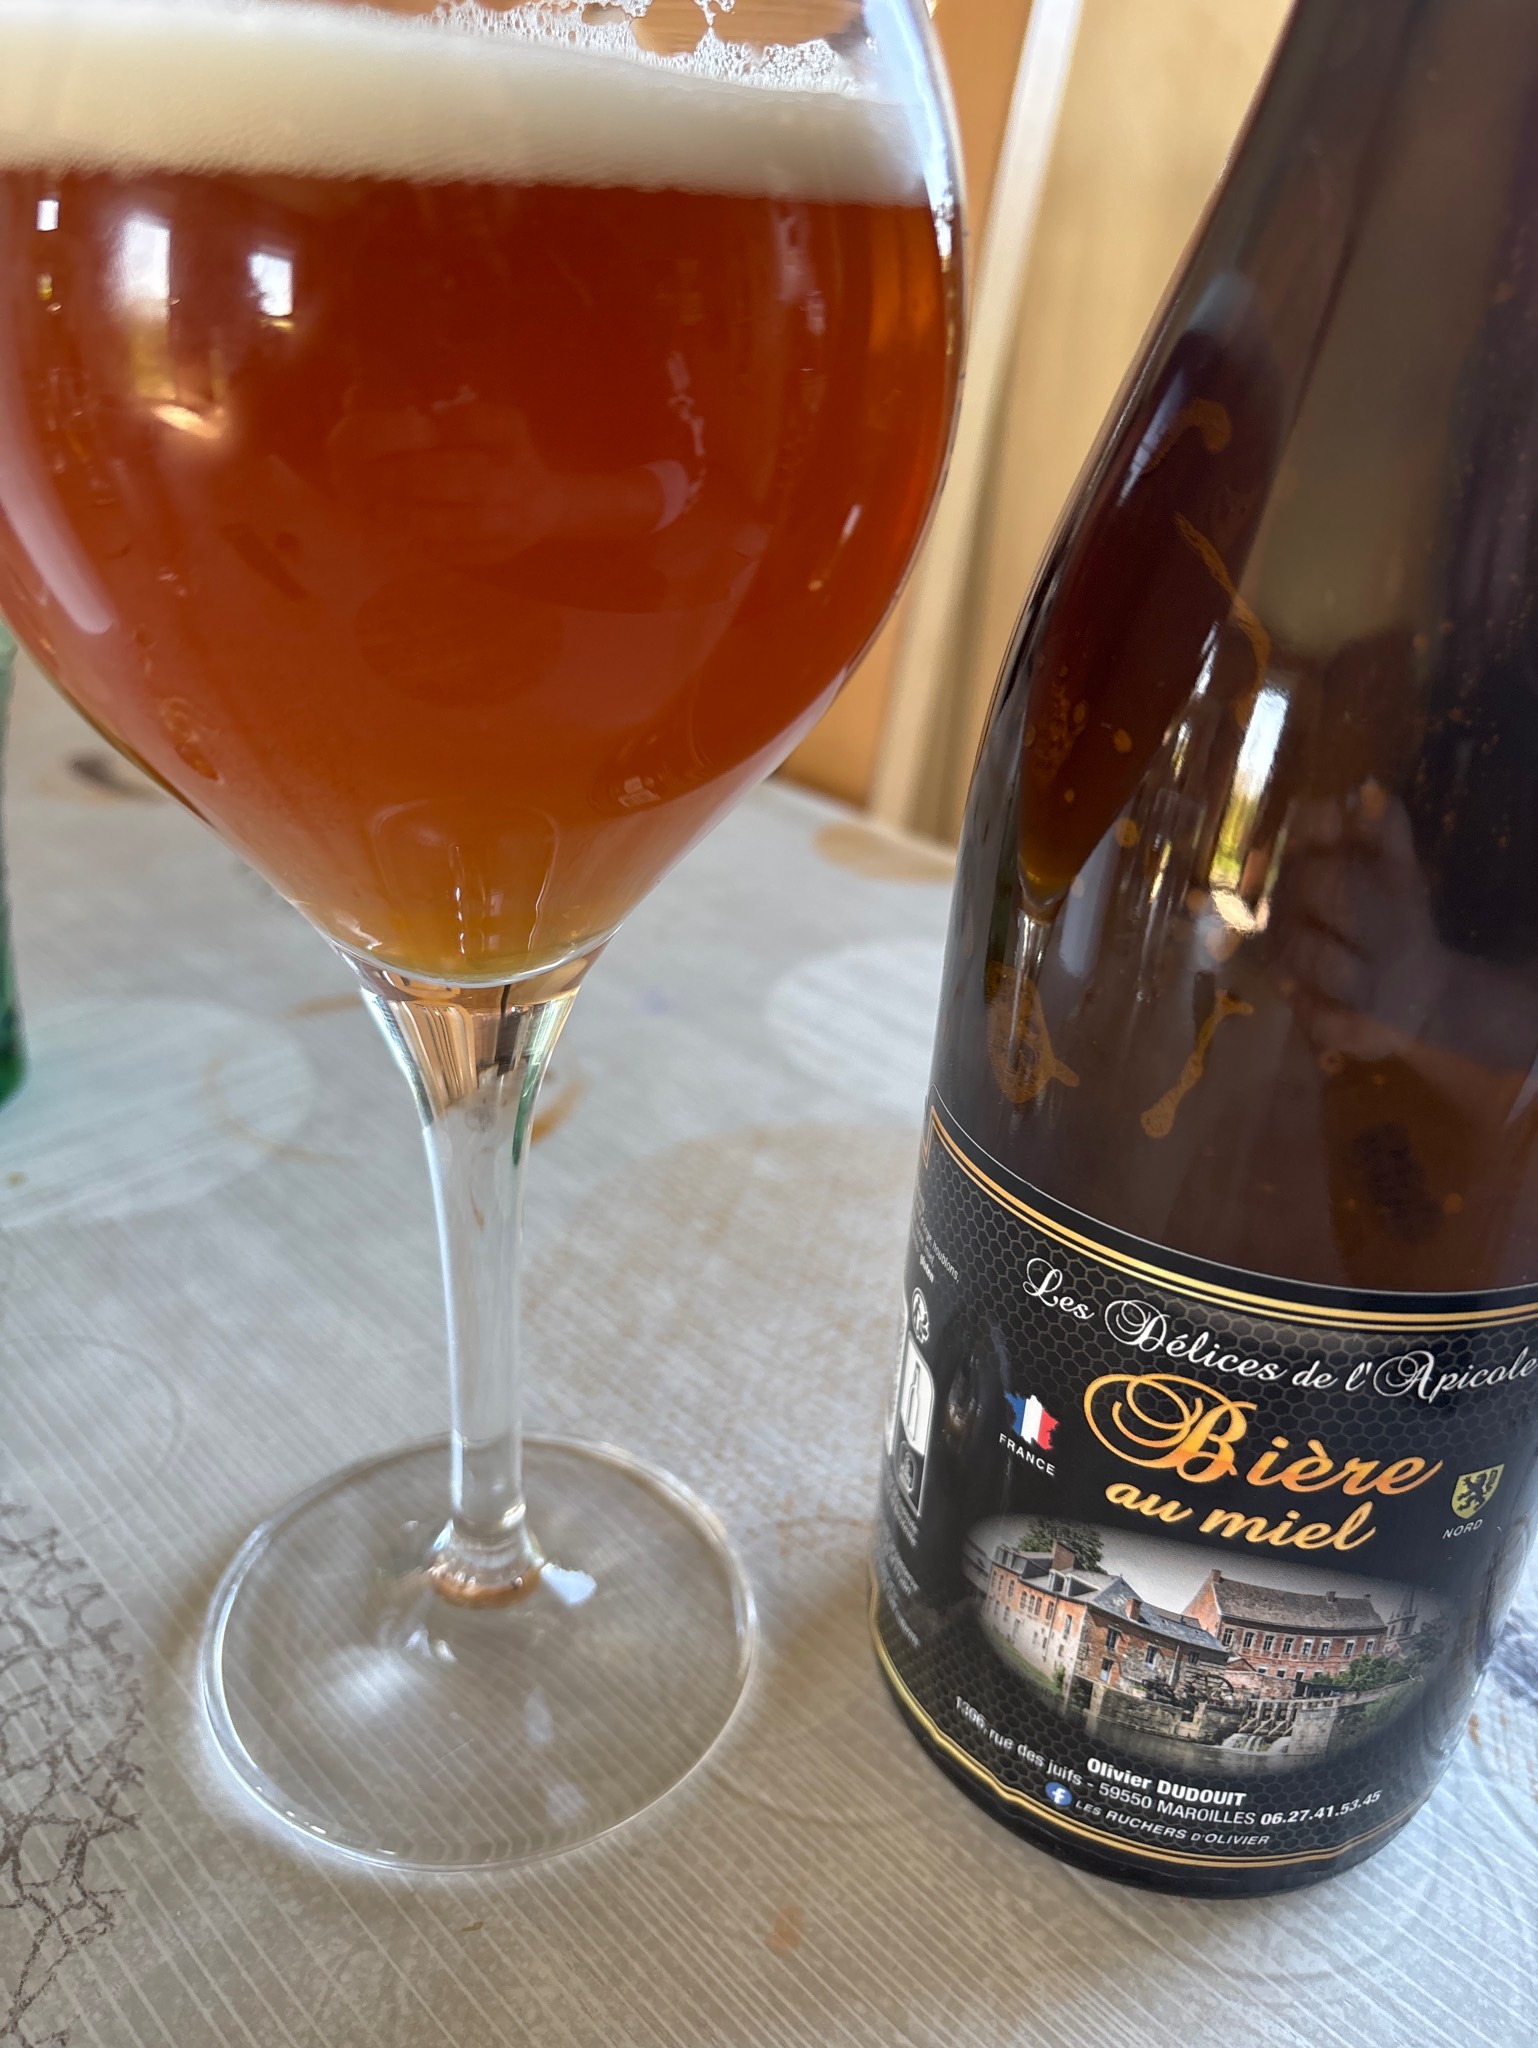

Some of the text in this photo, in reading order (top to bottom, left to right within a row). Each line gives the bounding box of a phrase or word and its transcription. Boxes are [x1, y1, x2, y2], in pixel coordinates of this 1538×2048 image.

[1022, 1257, 1538, 1403] Les Délices de l'Apicole
[999, 1432, 1056, 1476] FRANCE
[1083, 1372, 1443, 1495] Bière
[1104, 1482, 1377, 1551] au miel
[1442, 1518, 1484, 1540] NORD
[989, 1728, 1015, 1751] rue
[1017, 1743, 1046, 1767] des
[1046, 1758, 1083, 1787] juifs
[1098, 1782, 1153, 1810] 59550
[1156, 1799, 1257, 1826] MAROILLES
[1259, 1789, 1383, 1826] 06.27.41.53.45
[1087, 1757, 1248, 1807] Olivier DUDOUIT
[1075, 1800, 1103, 1816] LES
[1105, 1810, 1188, 1841] RUCHERS
